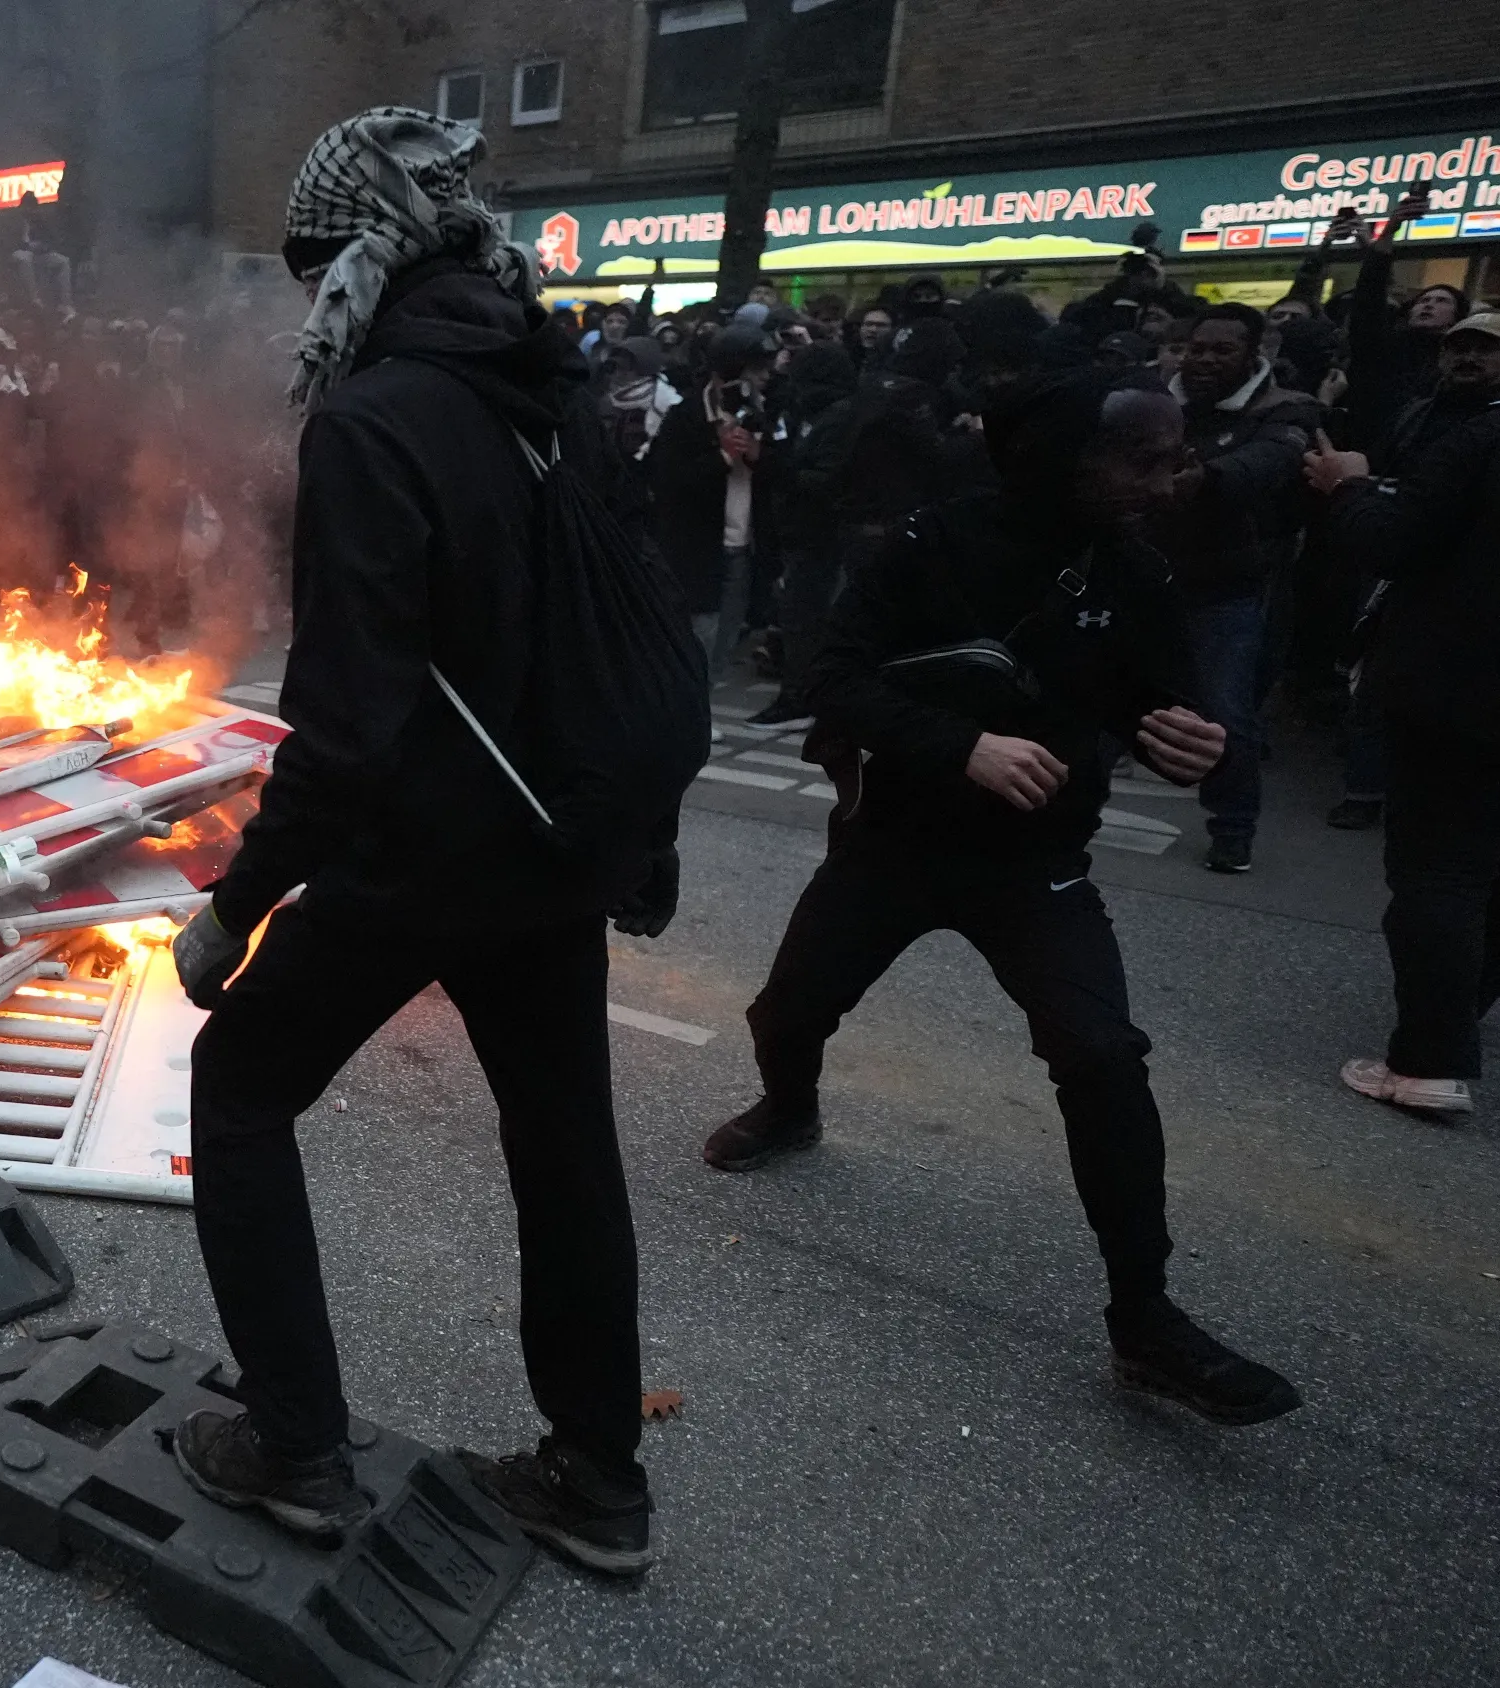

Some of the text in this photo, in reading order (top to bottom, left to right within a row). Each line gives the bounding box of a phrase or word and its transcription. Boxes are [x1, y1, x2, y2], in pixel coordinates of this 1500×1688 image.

[600, 181, 1158, 247] APOTHE AM LOHMÜHLENPARK
[1201, 186, 1390, 230] ganzheitlich
[1397, 180, 1469, 211] nd
